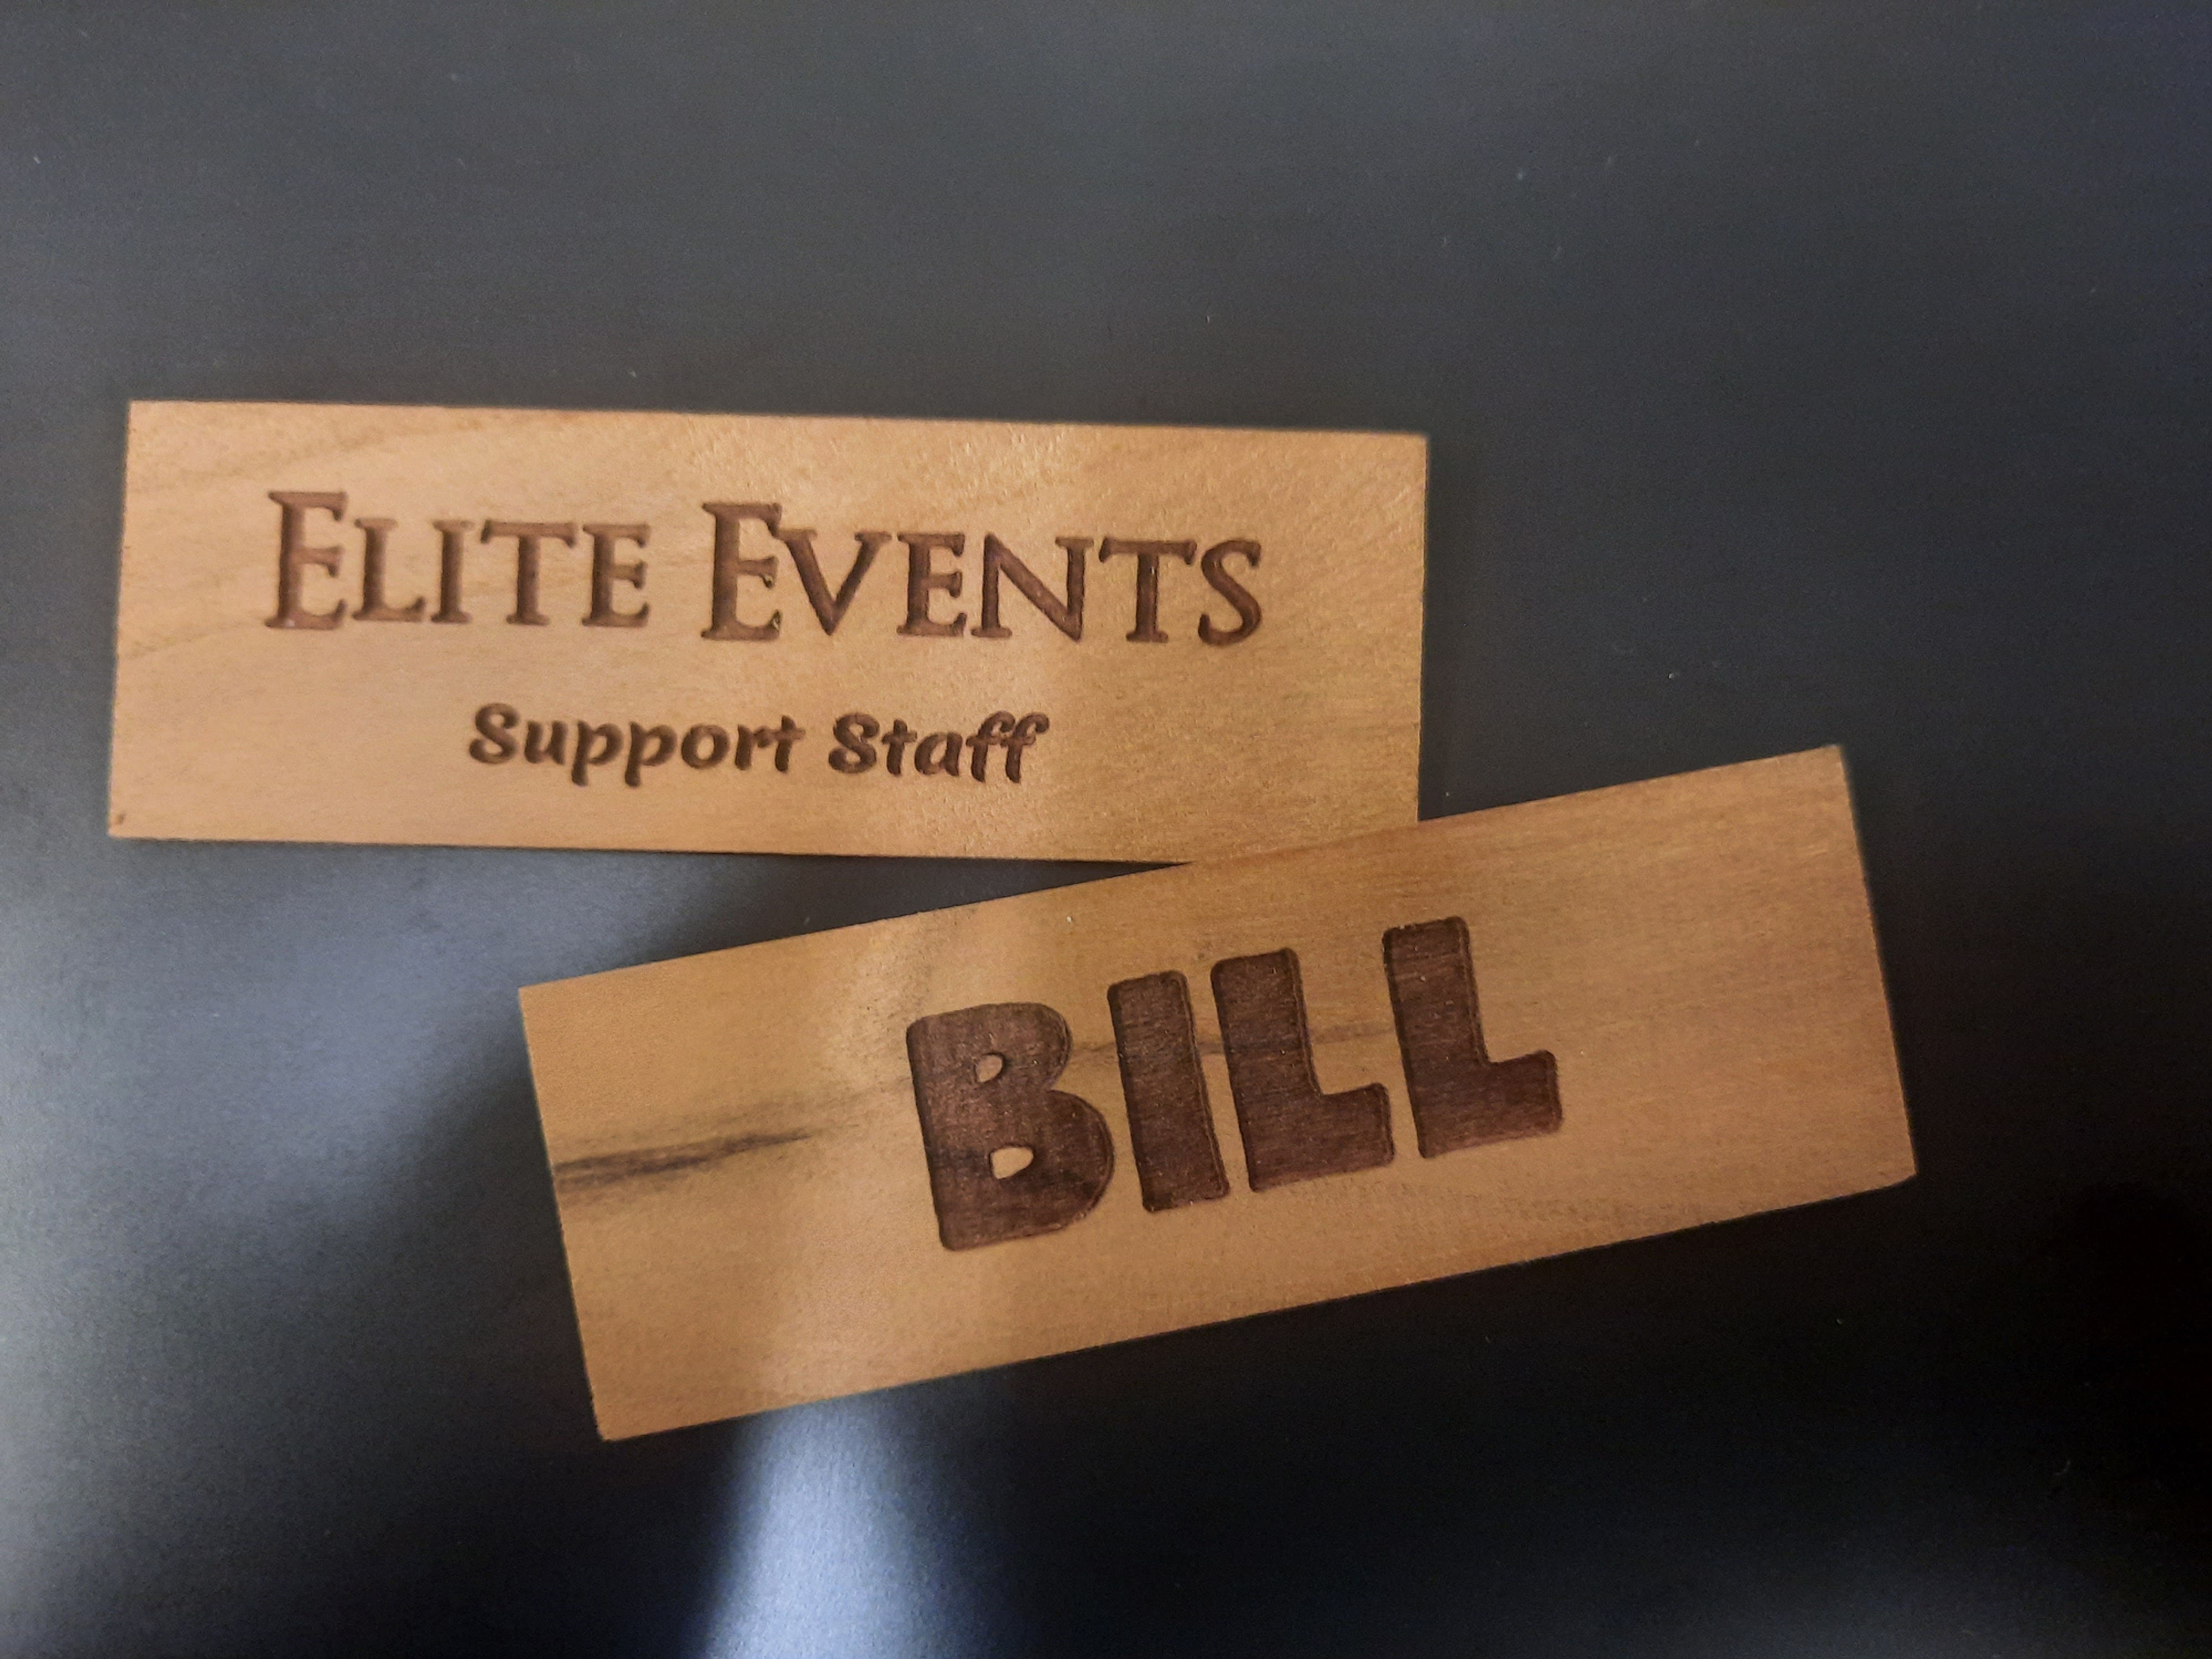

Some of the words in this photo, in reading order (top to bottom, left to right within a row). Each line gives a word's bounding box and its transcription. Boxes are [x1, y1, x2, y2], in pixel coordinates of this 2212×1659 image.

[265, 491, 651, 630] ELITE
[700, 502, 1263, 648] EVENTS
[469, 702, 805, 787] Support
[829, 711, 1051, 783] Staff
[906, 916, 1564, 1251] BILL
